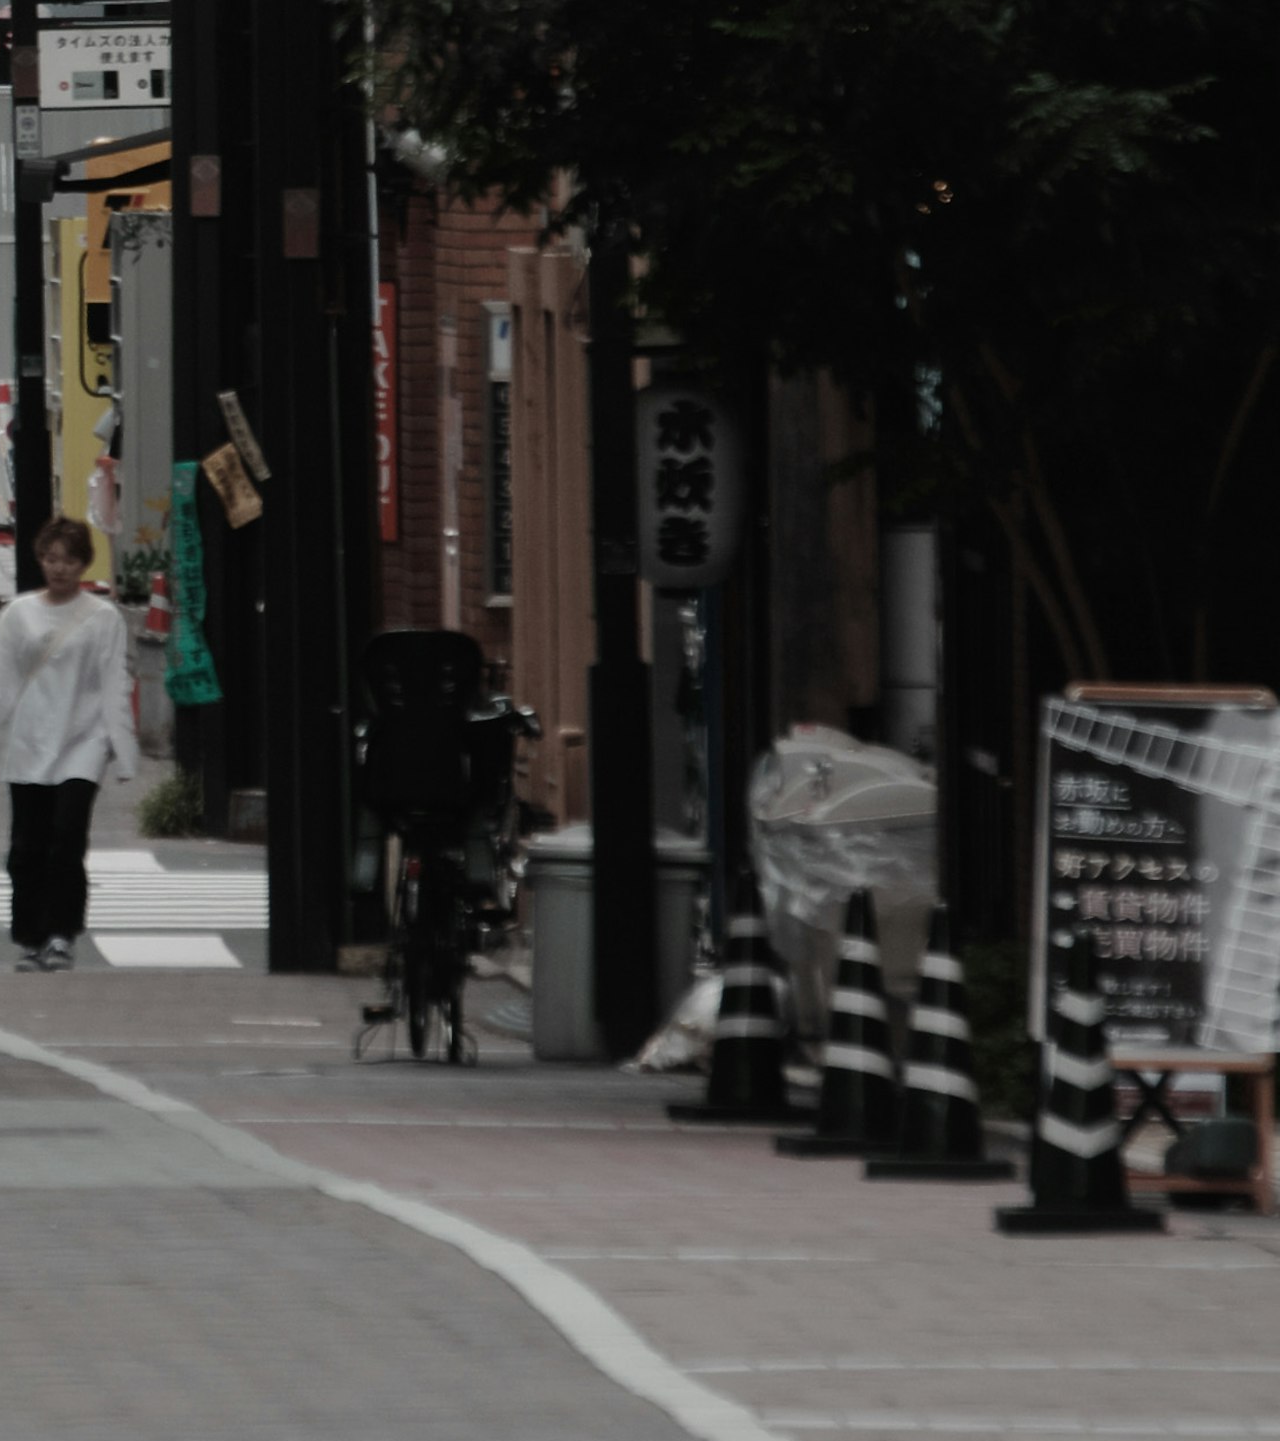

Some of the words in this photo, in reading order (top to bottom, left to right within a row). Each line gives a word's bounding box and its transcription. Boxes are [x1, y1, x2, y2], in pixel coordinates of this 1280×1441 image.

[1054, 771, 1130, 804] 赤坂に
[1078, 884, 1212, 925] 賃貸物件
